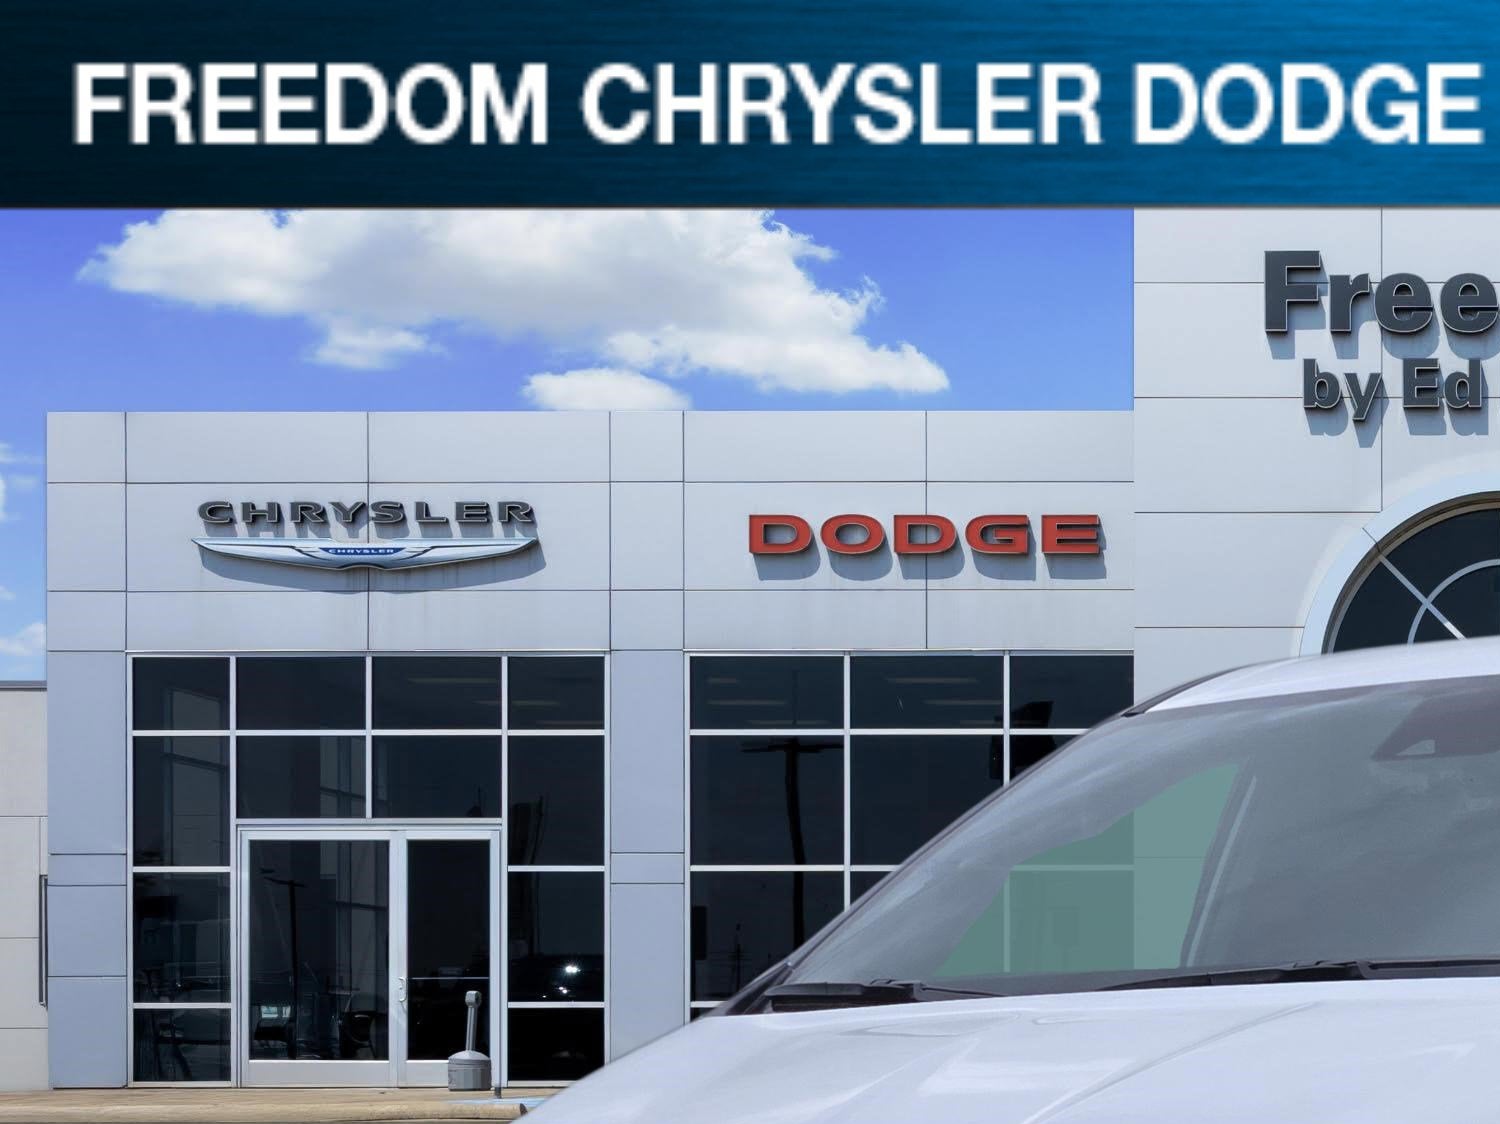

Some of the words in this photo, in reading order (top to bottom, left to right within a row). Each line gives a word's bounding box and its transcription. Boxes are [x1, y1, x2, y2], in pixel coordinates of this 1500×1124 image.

[1303, 358, 1382, 421] by
[1402, 358, 1482, 409] Ed
[197, 500, 533, 524] CHRYSLER
[748, 513, 1100, 554] DODGE
